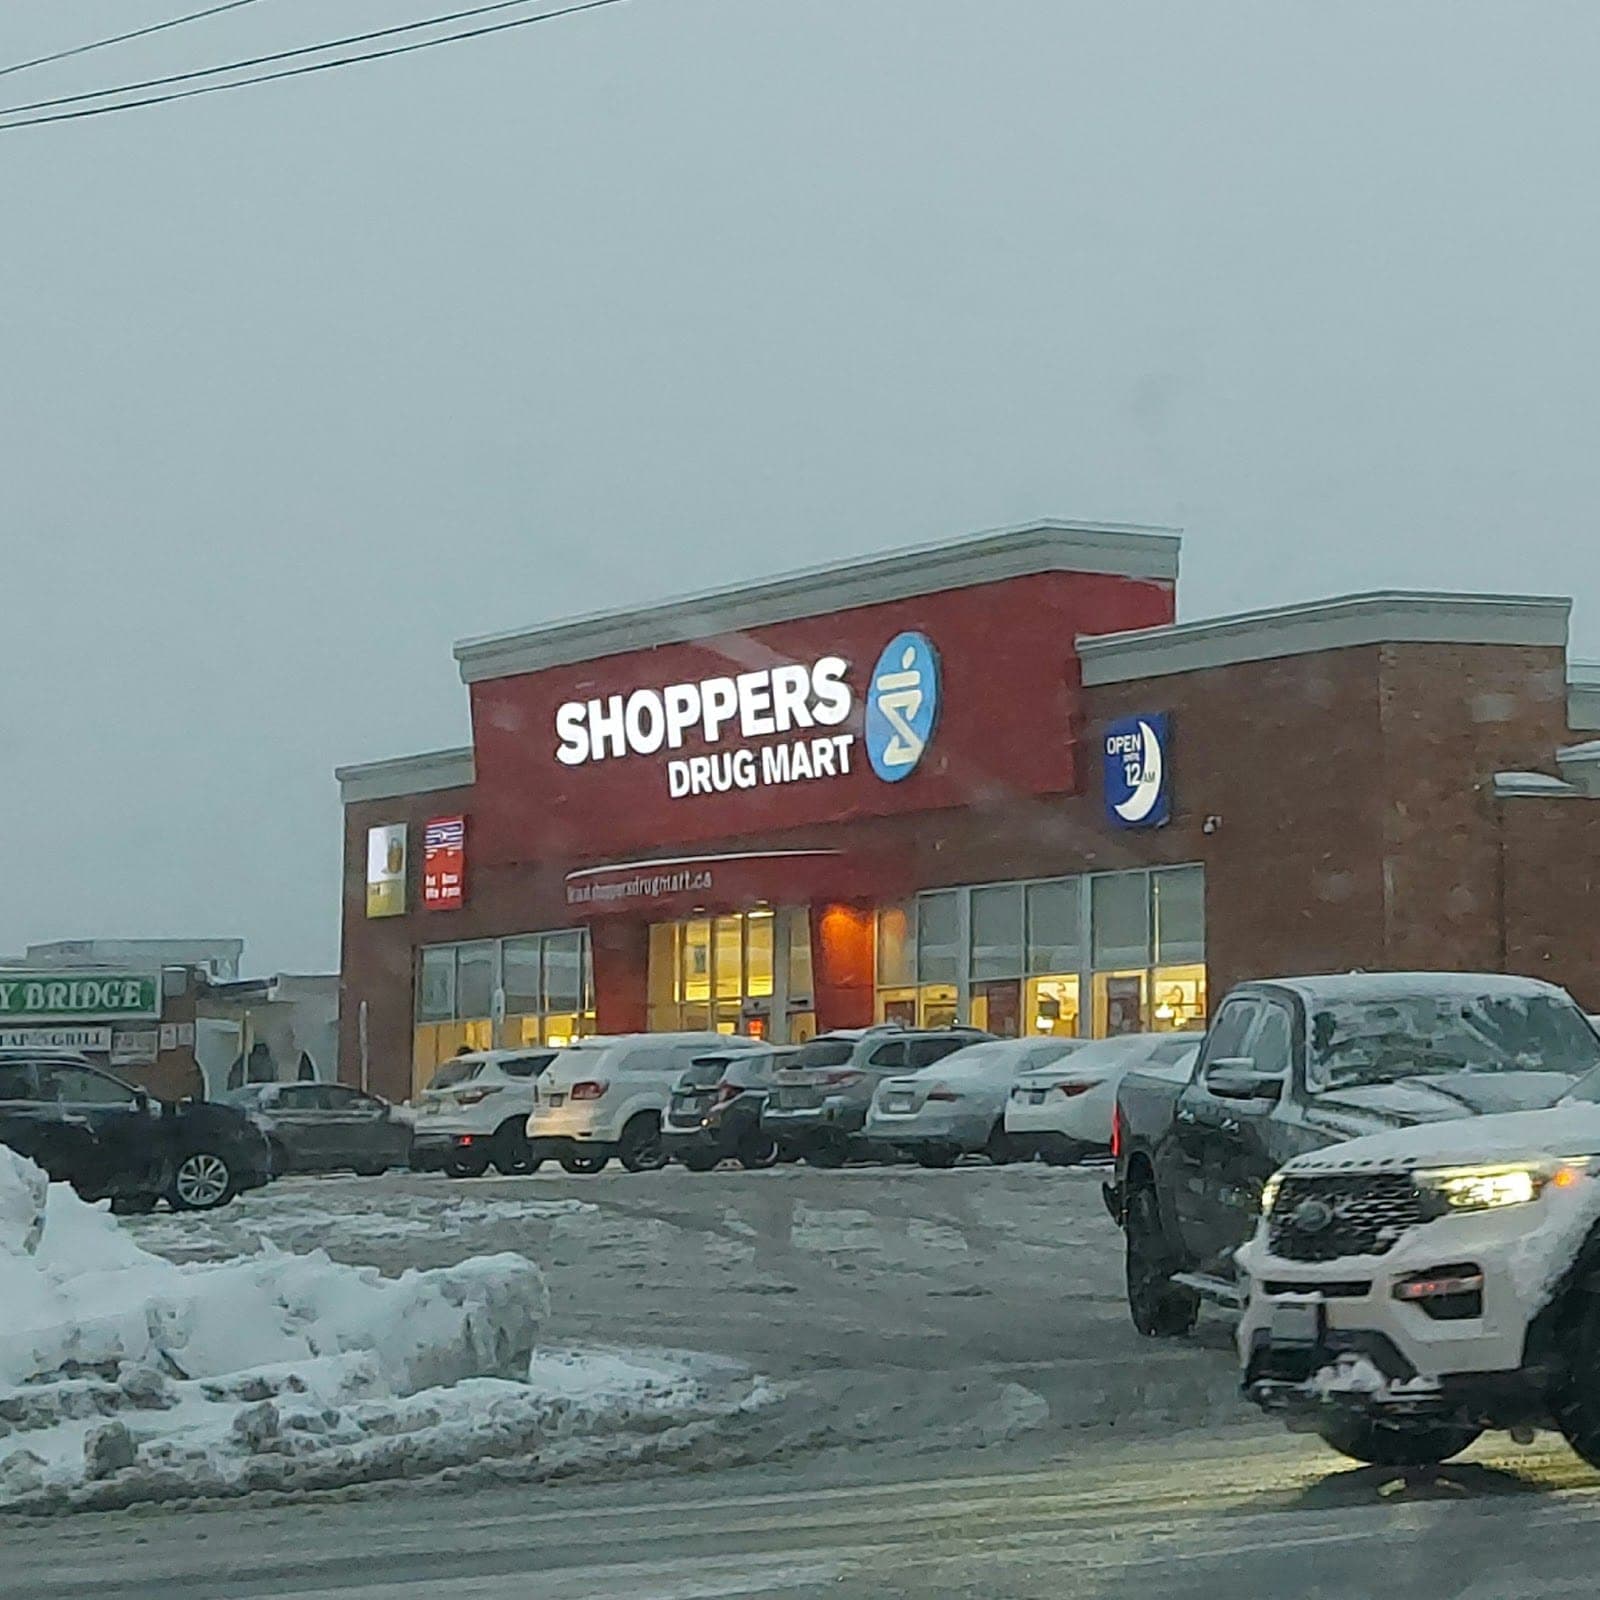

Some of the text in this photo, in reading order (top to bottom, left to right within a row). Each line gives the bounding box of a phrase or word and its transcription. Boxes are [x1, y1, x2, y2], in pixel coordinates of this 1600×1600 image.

[556, 656, 852, 766] SHOPPERS
[1107, 733, 1141, 754] OPEN
[668, 735, 854, 798] DRUG MART
[1124, 763, 1141, 786] 12
[24, 981, 141, 1009] BRIDGE
